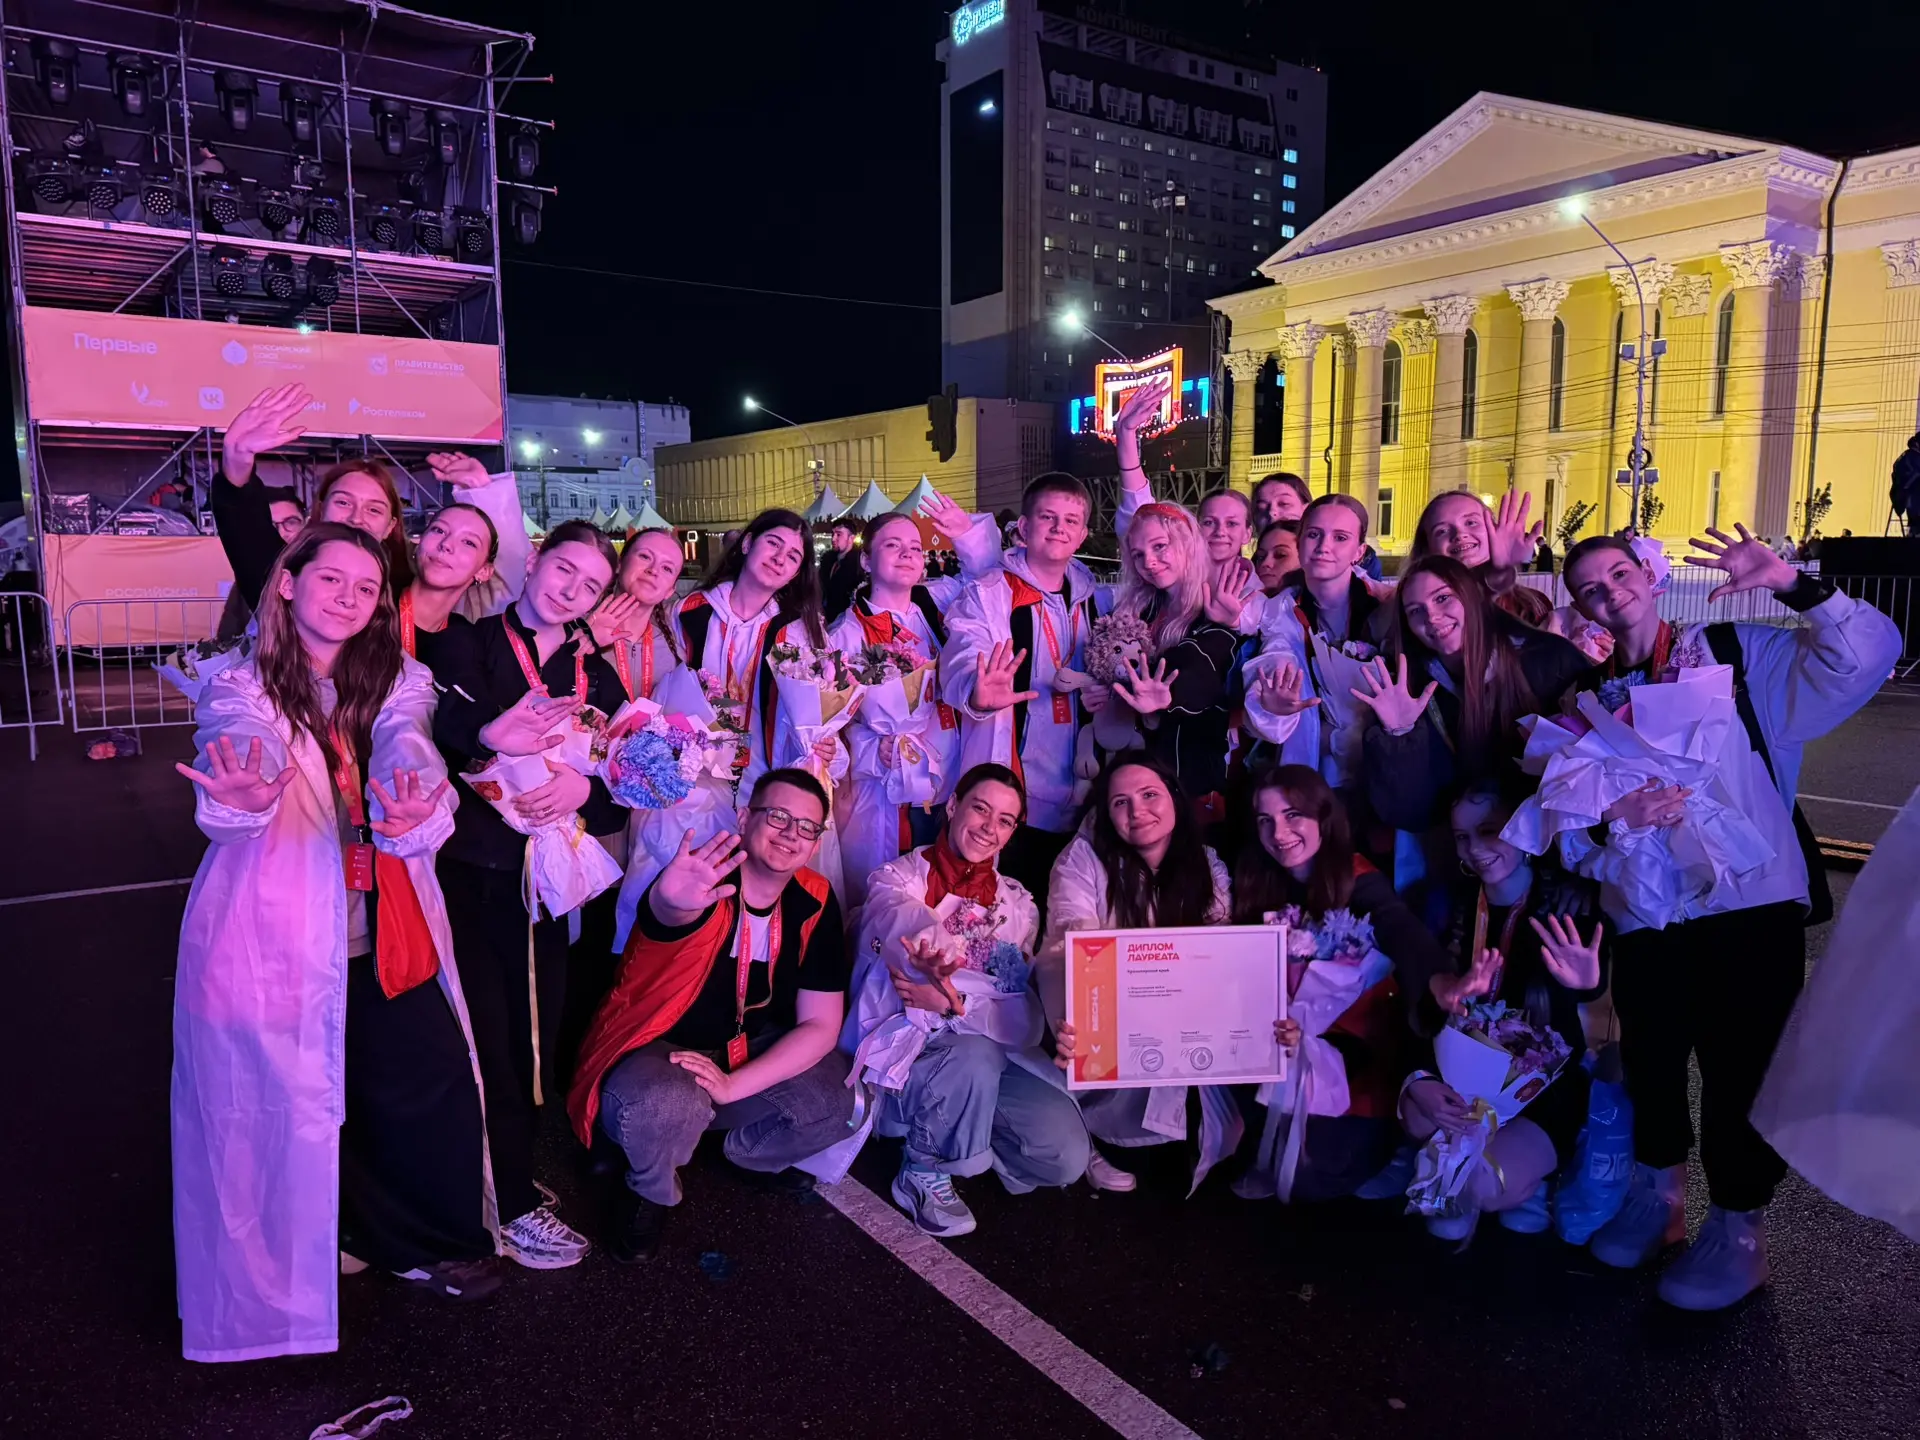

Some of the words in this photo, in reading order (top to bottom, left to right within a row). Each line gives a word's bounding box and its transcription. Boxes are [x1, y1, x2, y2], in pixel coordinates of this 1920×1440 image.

[74, 332, 158, 356] Первые
[394, 359, 464, 371] ПРАВИТЕЛЬСТВО
[362, 406, 426, 418] Ростелеком
[106, 586, 198, 598] РОССИЙСКАЯ
[1128, 942, 1174, 952] ДИПЛОМ
[1128, 952, 1180, 962] ЛАУРЕАТА
